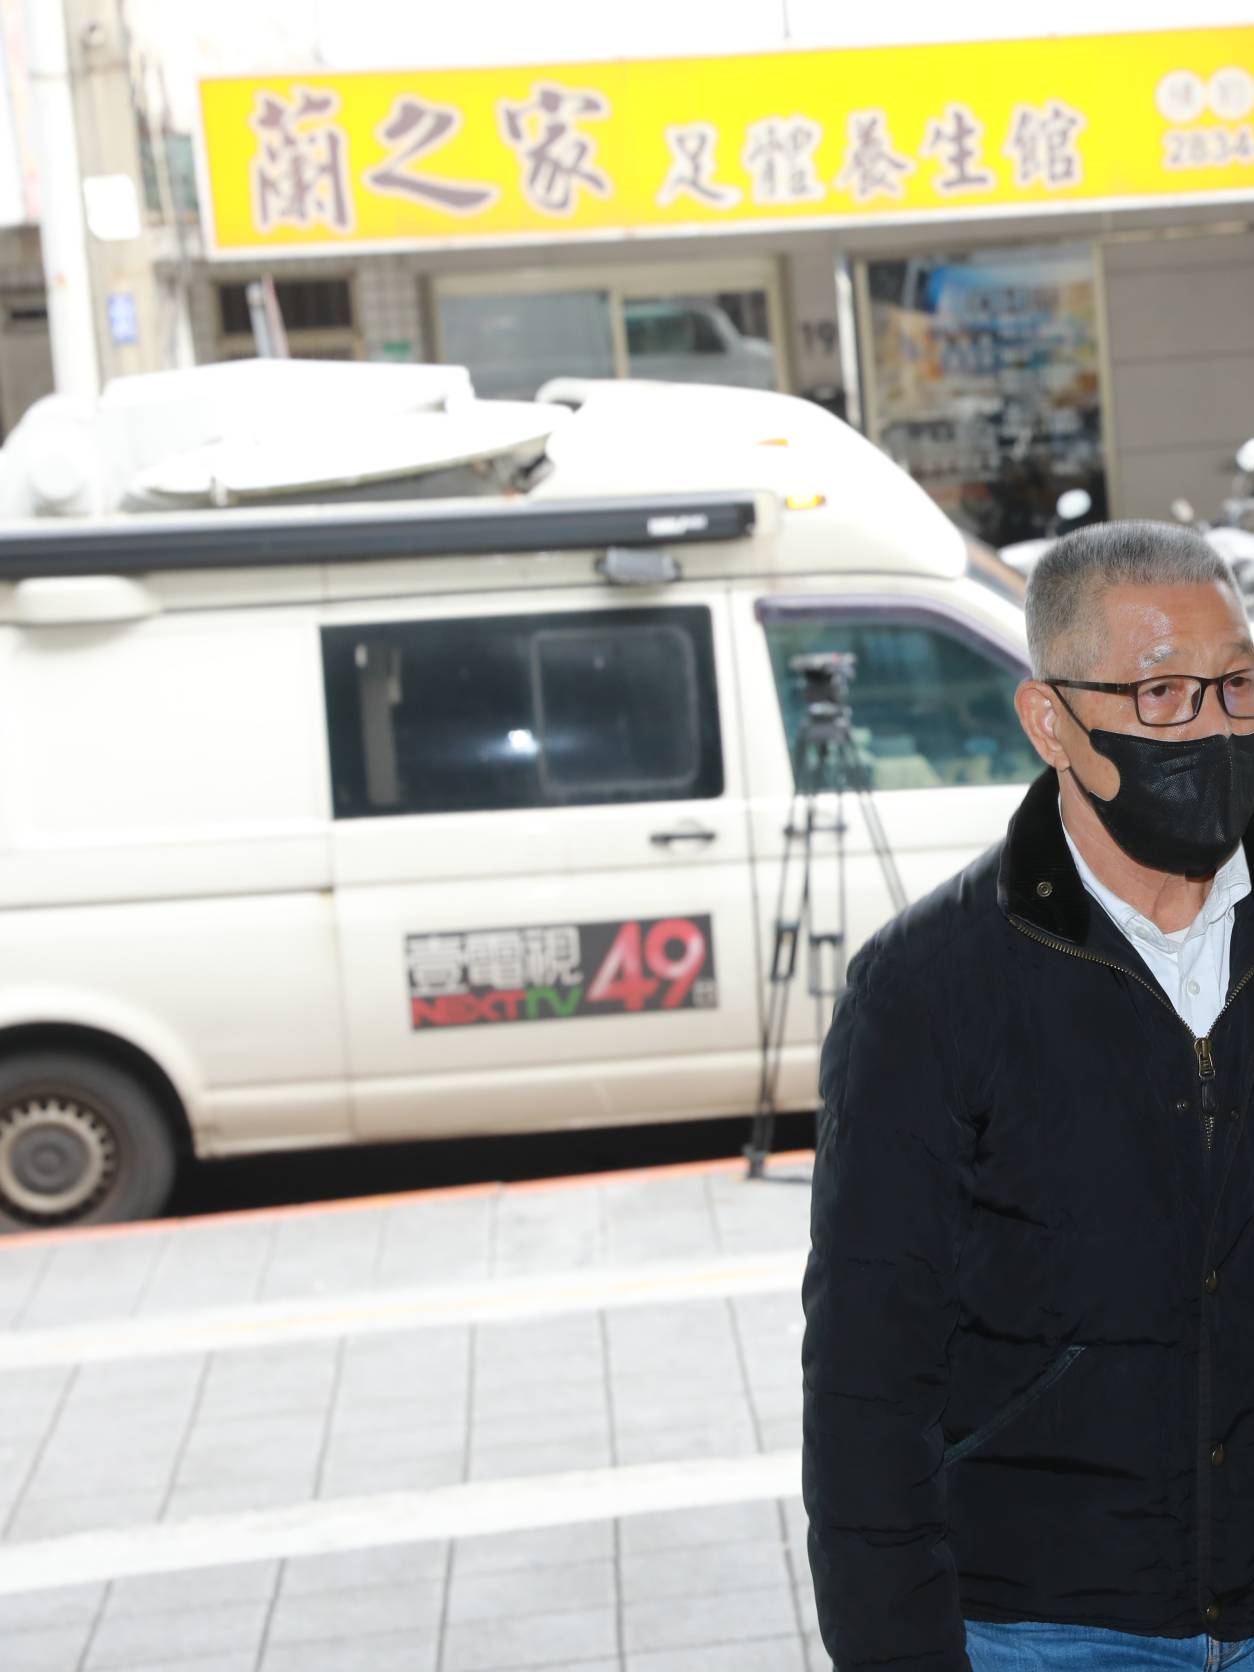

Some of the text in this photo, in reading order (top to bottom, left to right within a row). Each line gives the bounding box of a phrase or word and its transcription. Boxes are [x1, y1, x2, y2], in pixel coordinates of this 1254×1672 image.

[252, 84, 1089, 234] 蘭之家 足體養生館
[584, 916, 707, 1012] 49
